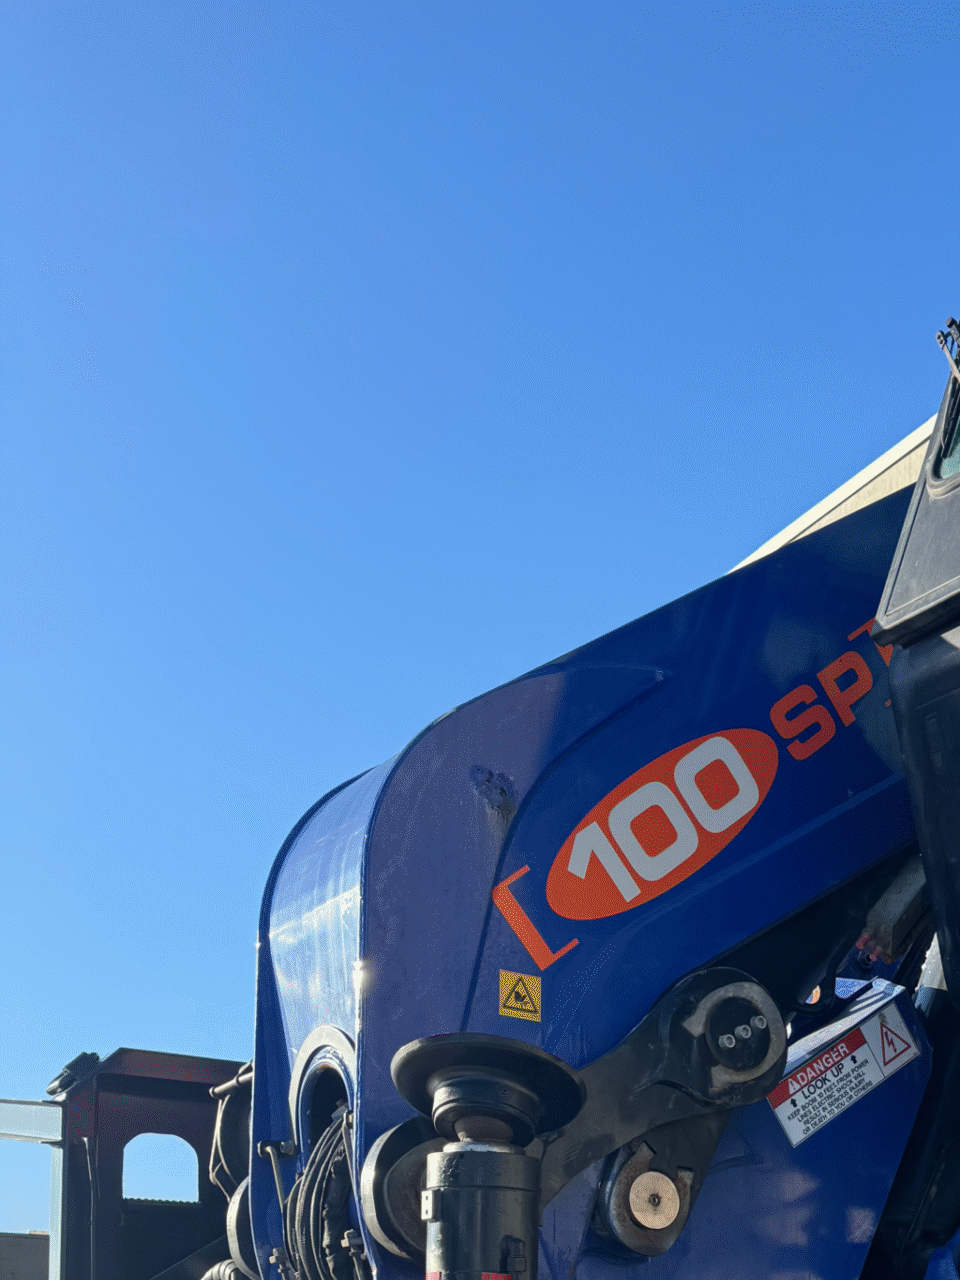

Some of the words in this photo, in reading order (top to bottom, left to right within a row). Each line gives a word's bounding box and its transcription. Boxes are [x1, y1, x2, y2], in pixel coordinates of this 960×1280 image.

[568, 736, 759, 904] 100
[796, 1043, 850, 1086] DANGER
[801, 1074, 831, 1100] LOOK
[831, 1063, 845, 1078] UP
[787, 1109, 801, 1121] KEEP
[800, 1097, 817, 1111] BOOM
[836, 1072, 851, 1085] FROM
[851, 1059, 870, 1074] POWER
[802, 1127, 811, 1135] OR
[811, 1115, 828, 1130] DEATH
[827, 1108, 835, 1116] TO
[834, 1101, 846, 1110] YOU
[845, 1094, 854, 1103] OR
[853, 1080, 873, 1097] OTHERS
[803, 1110, 822, 1126] RESULT
[821, 1105, 828, 1113] IN
[827, 1092, 850, 1109] SERIOUS
[849, 1078, 866, 1093] INJURY
[812, 1093, 836, 1112] ELECTRIC
[836, 1079, 853, 1093] SHOCK
[853, 1070, 866, 1081] WILL
